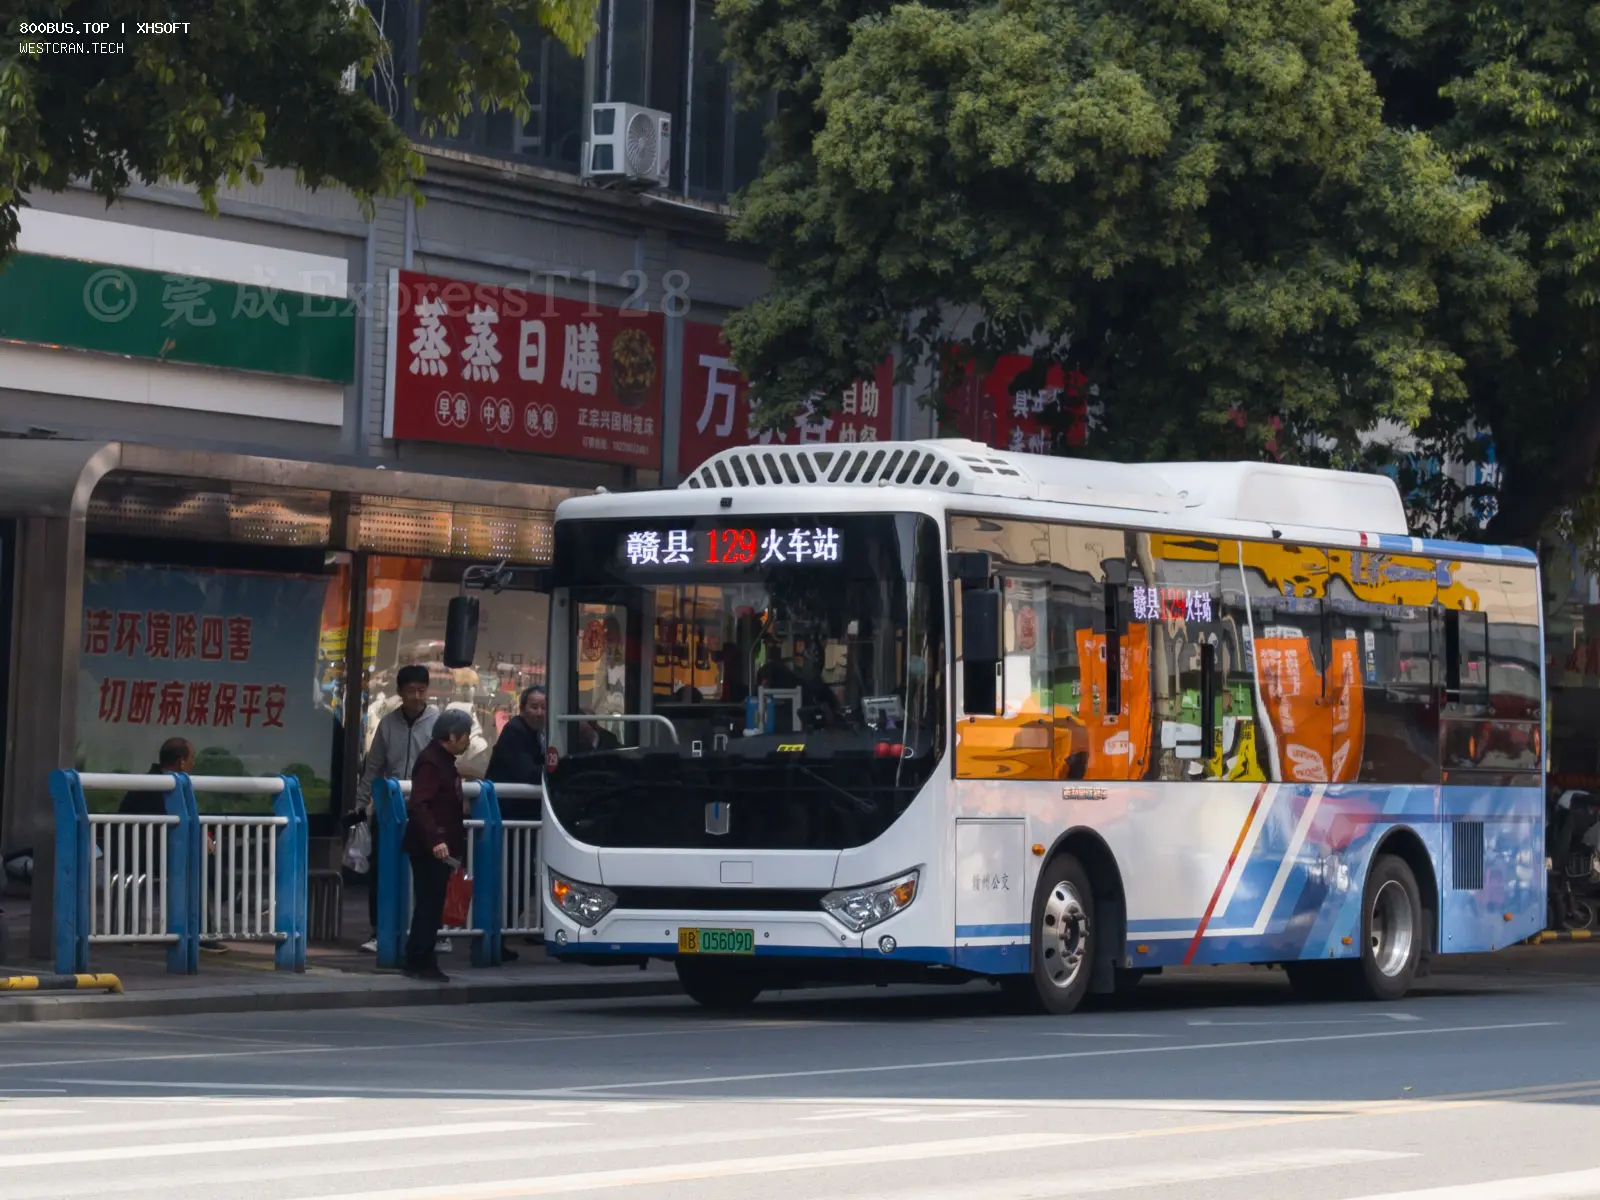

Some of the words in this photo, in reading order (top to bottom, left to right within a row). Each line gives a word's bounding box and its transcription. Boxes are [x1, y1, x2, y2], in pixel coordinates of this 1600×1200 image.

[408, 296, 601, 396] 蒸蒸日膳
[437, 398, 467, 423] 早餐
[483, 403, 512, 427] 中餐
[526, 408, 554, 432] 晚餐
[626, 529, 694, 564] 赣县
[704, 528, 757, 563] 129
[760, 527, 839, 563] 火车站
[84, 608, 252, 663] 洁环境除四害
[98, 677, 287, 728] 切断病媒保平安
